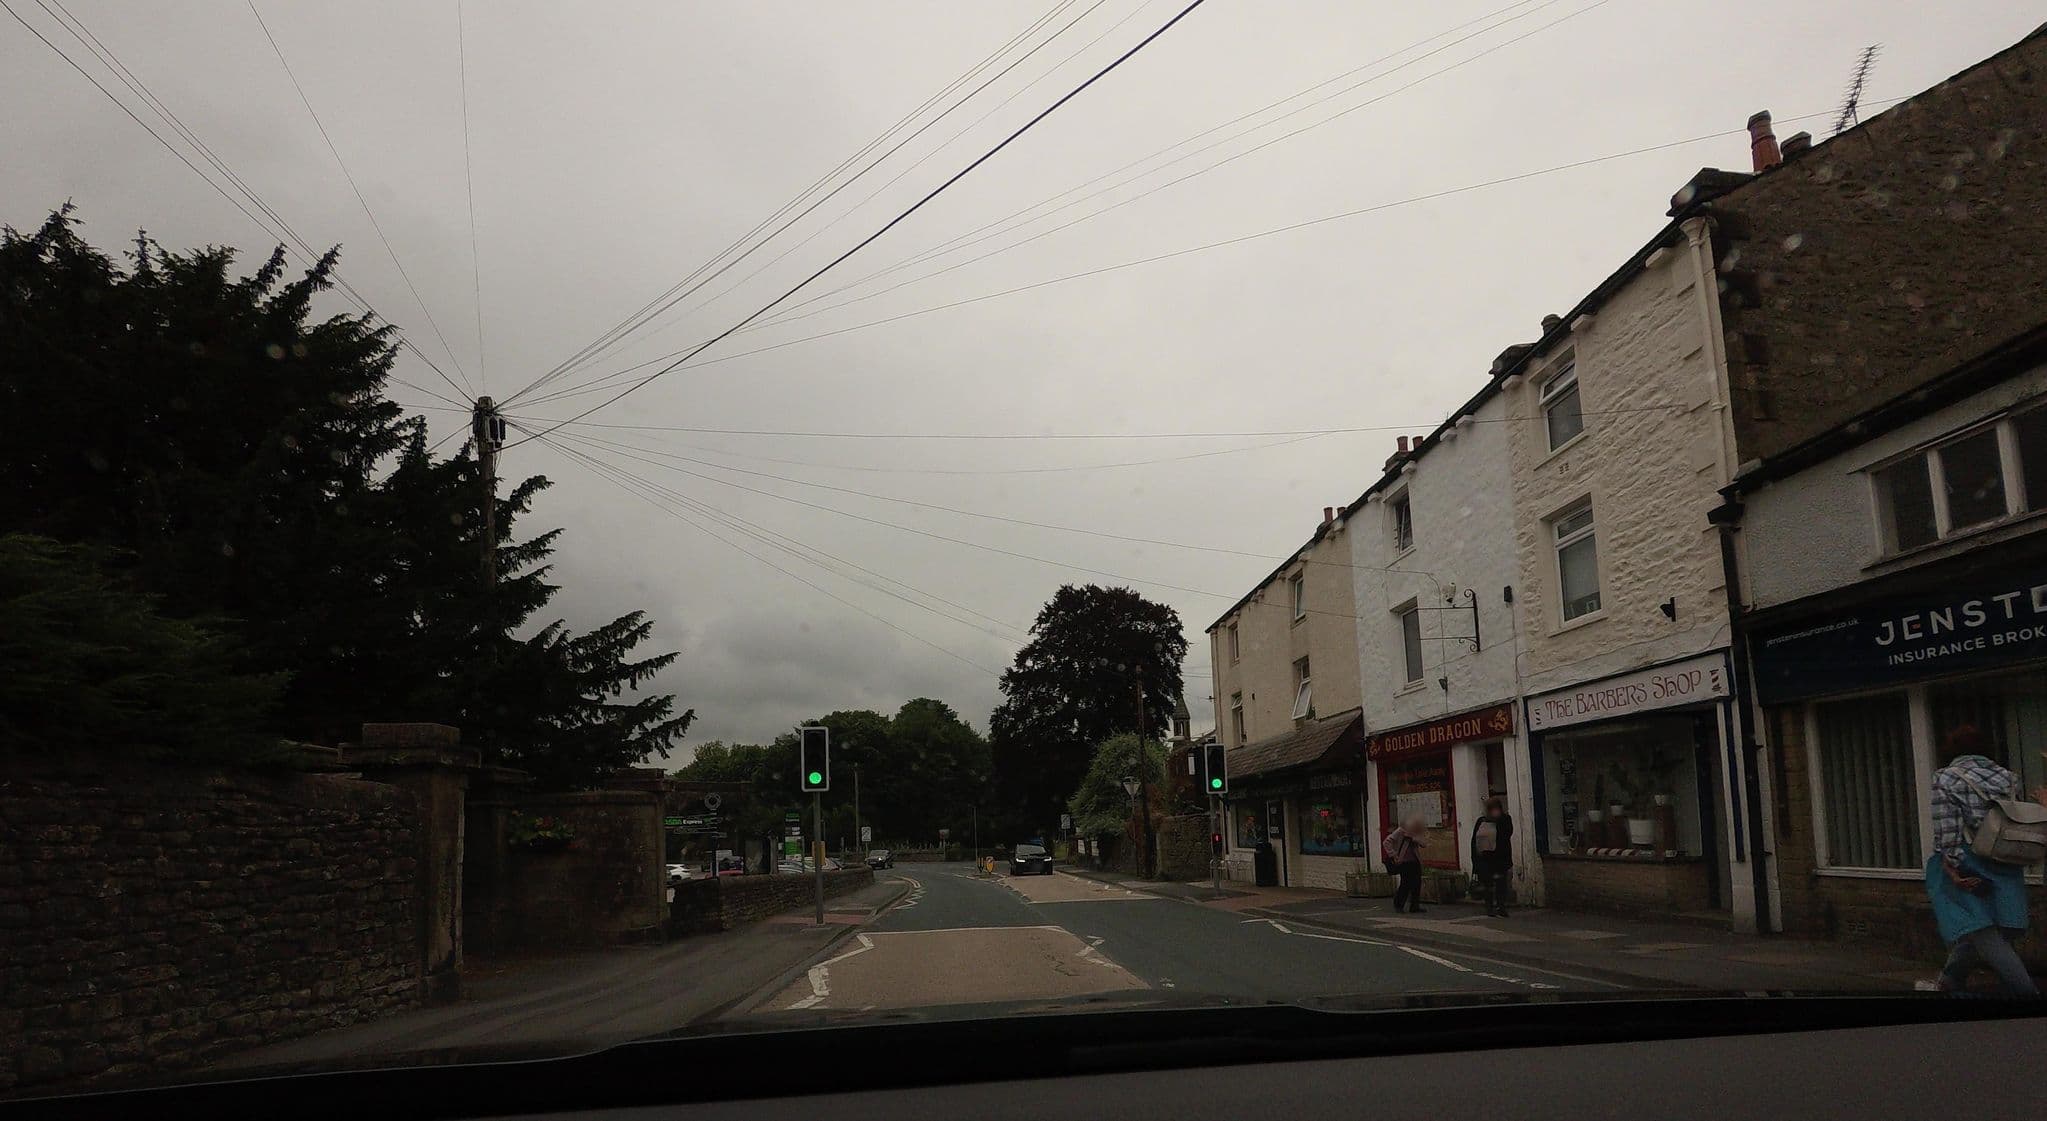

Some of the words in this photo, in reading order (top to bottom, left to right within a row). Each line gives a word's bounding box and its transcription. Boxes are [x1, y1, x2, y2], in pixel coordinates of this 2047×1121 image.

[1888, 637, 1986, 665] INSURANCE
[1992, 625, 2047, 646] BROK
[1575, 682, 1648, 715] BARBERS
[1385, 732, 1426, 753] GOLDEN
[1429, 718, 1482, 744] DRAGON
